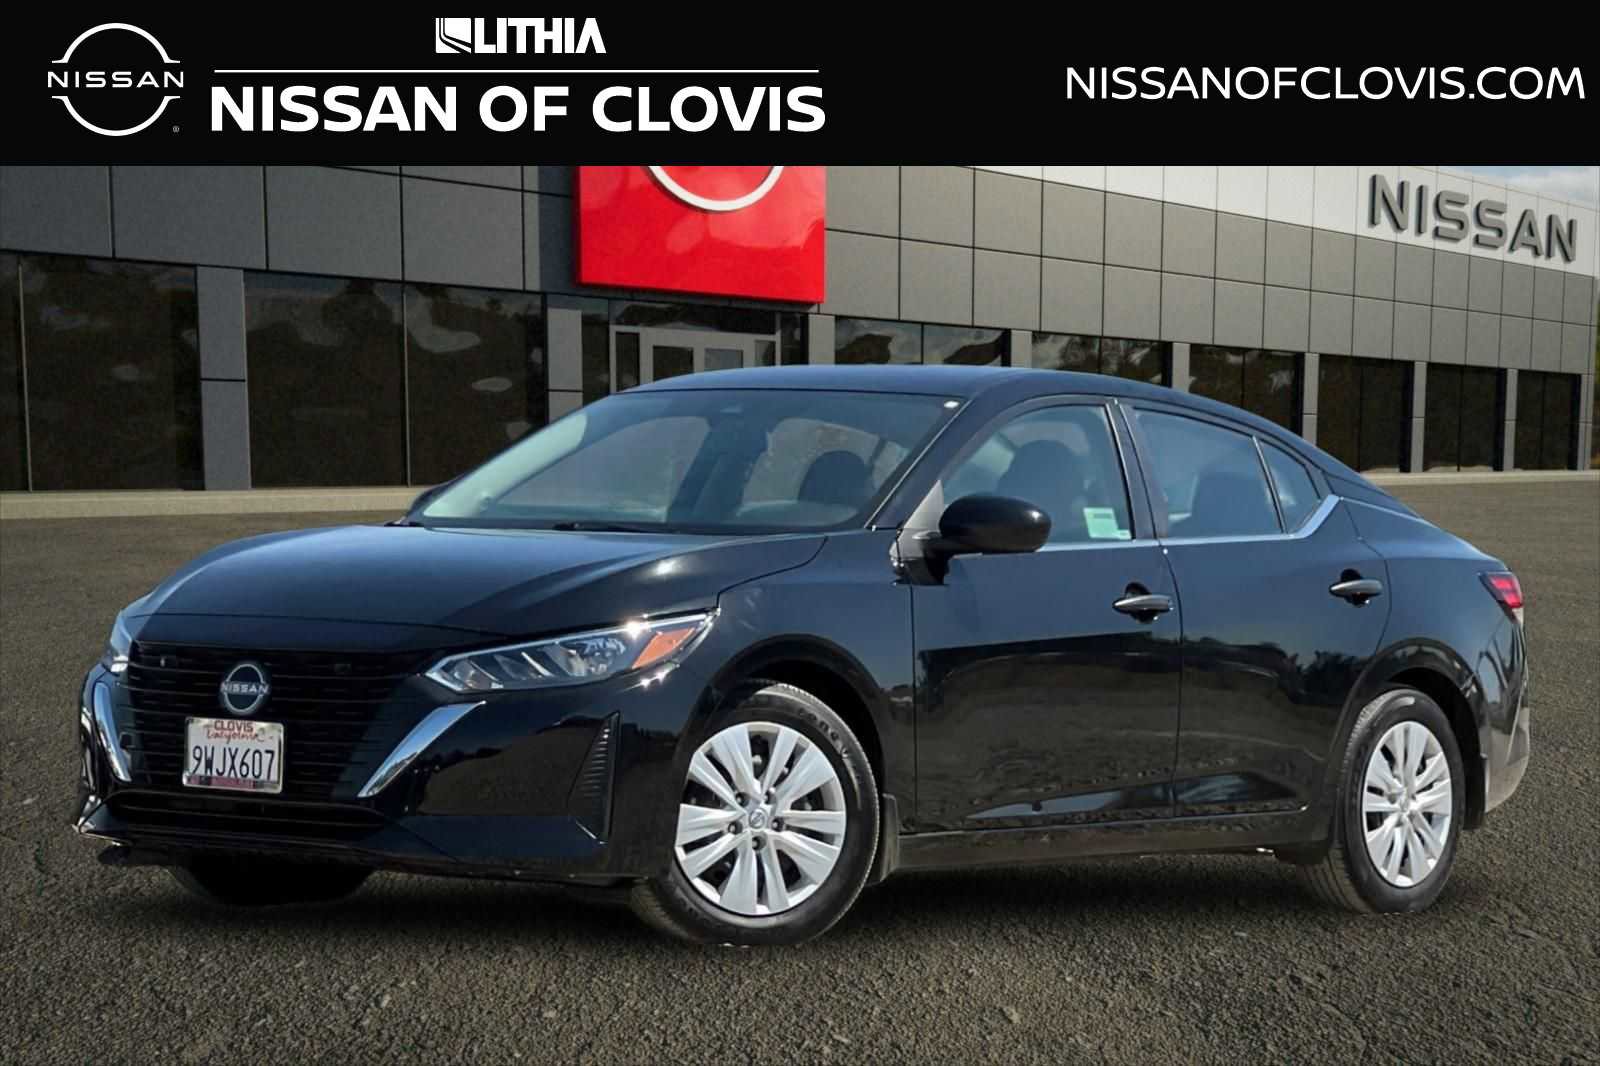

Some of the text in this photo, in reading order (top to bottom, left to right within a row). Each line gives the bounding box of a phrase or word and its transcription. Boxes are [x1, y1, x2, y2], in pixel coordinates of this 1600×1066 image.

[1368, 174, 1577, 263] NISSAN
[220, 681, 269, 695] NISSAN
[214, 720, 254, 732] CLOVIS
[192, 745, 275, 780] 9WJX607
